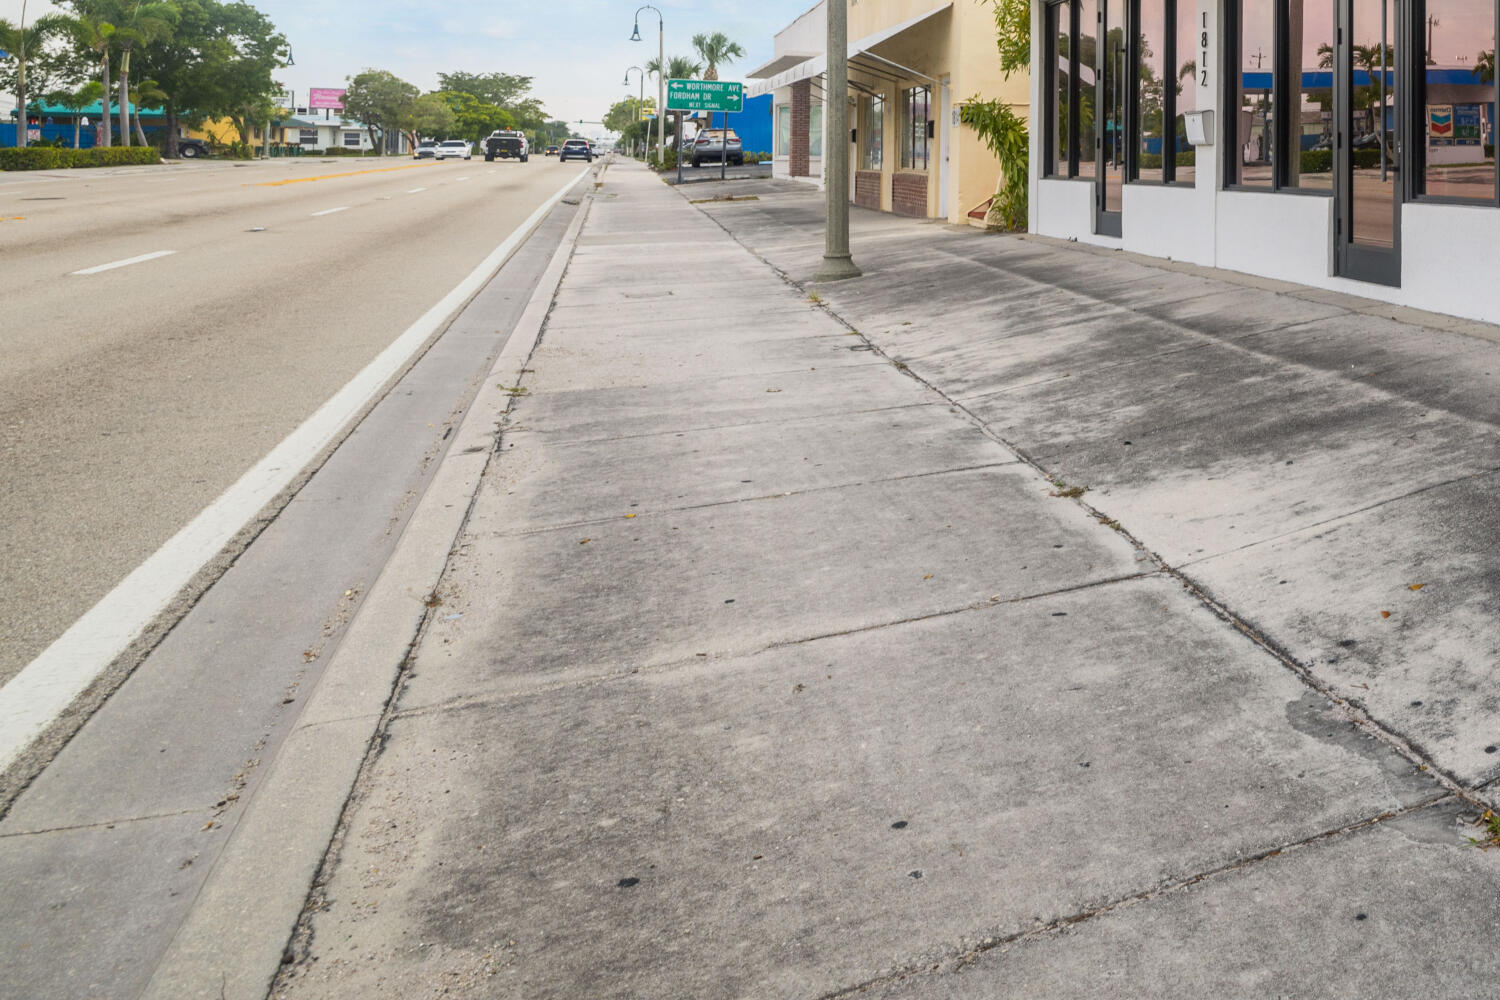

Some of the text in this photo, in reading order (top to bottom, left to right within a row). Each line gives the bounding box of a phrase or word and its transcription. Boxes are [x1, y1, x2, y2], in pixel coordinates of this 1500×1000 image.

[686, 82, 740, 92] WORTHMORE AVE
[670, 91, 712, 101] FORDHAM DR
